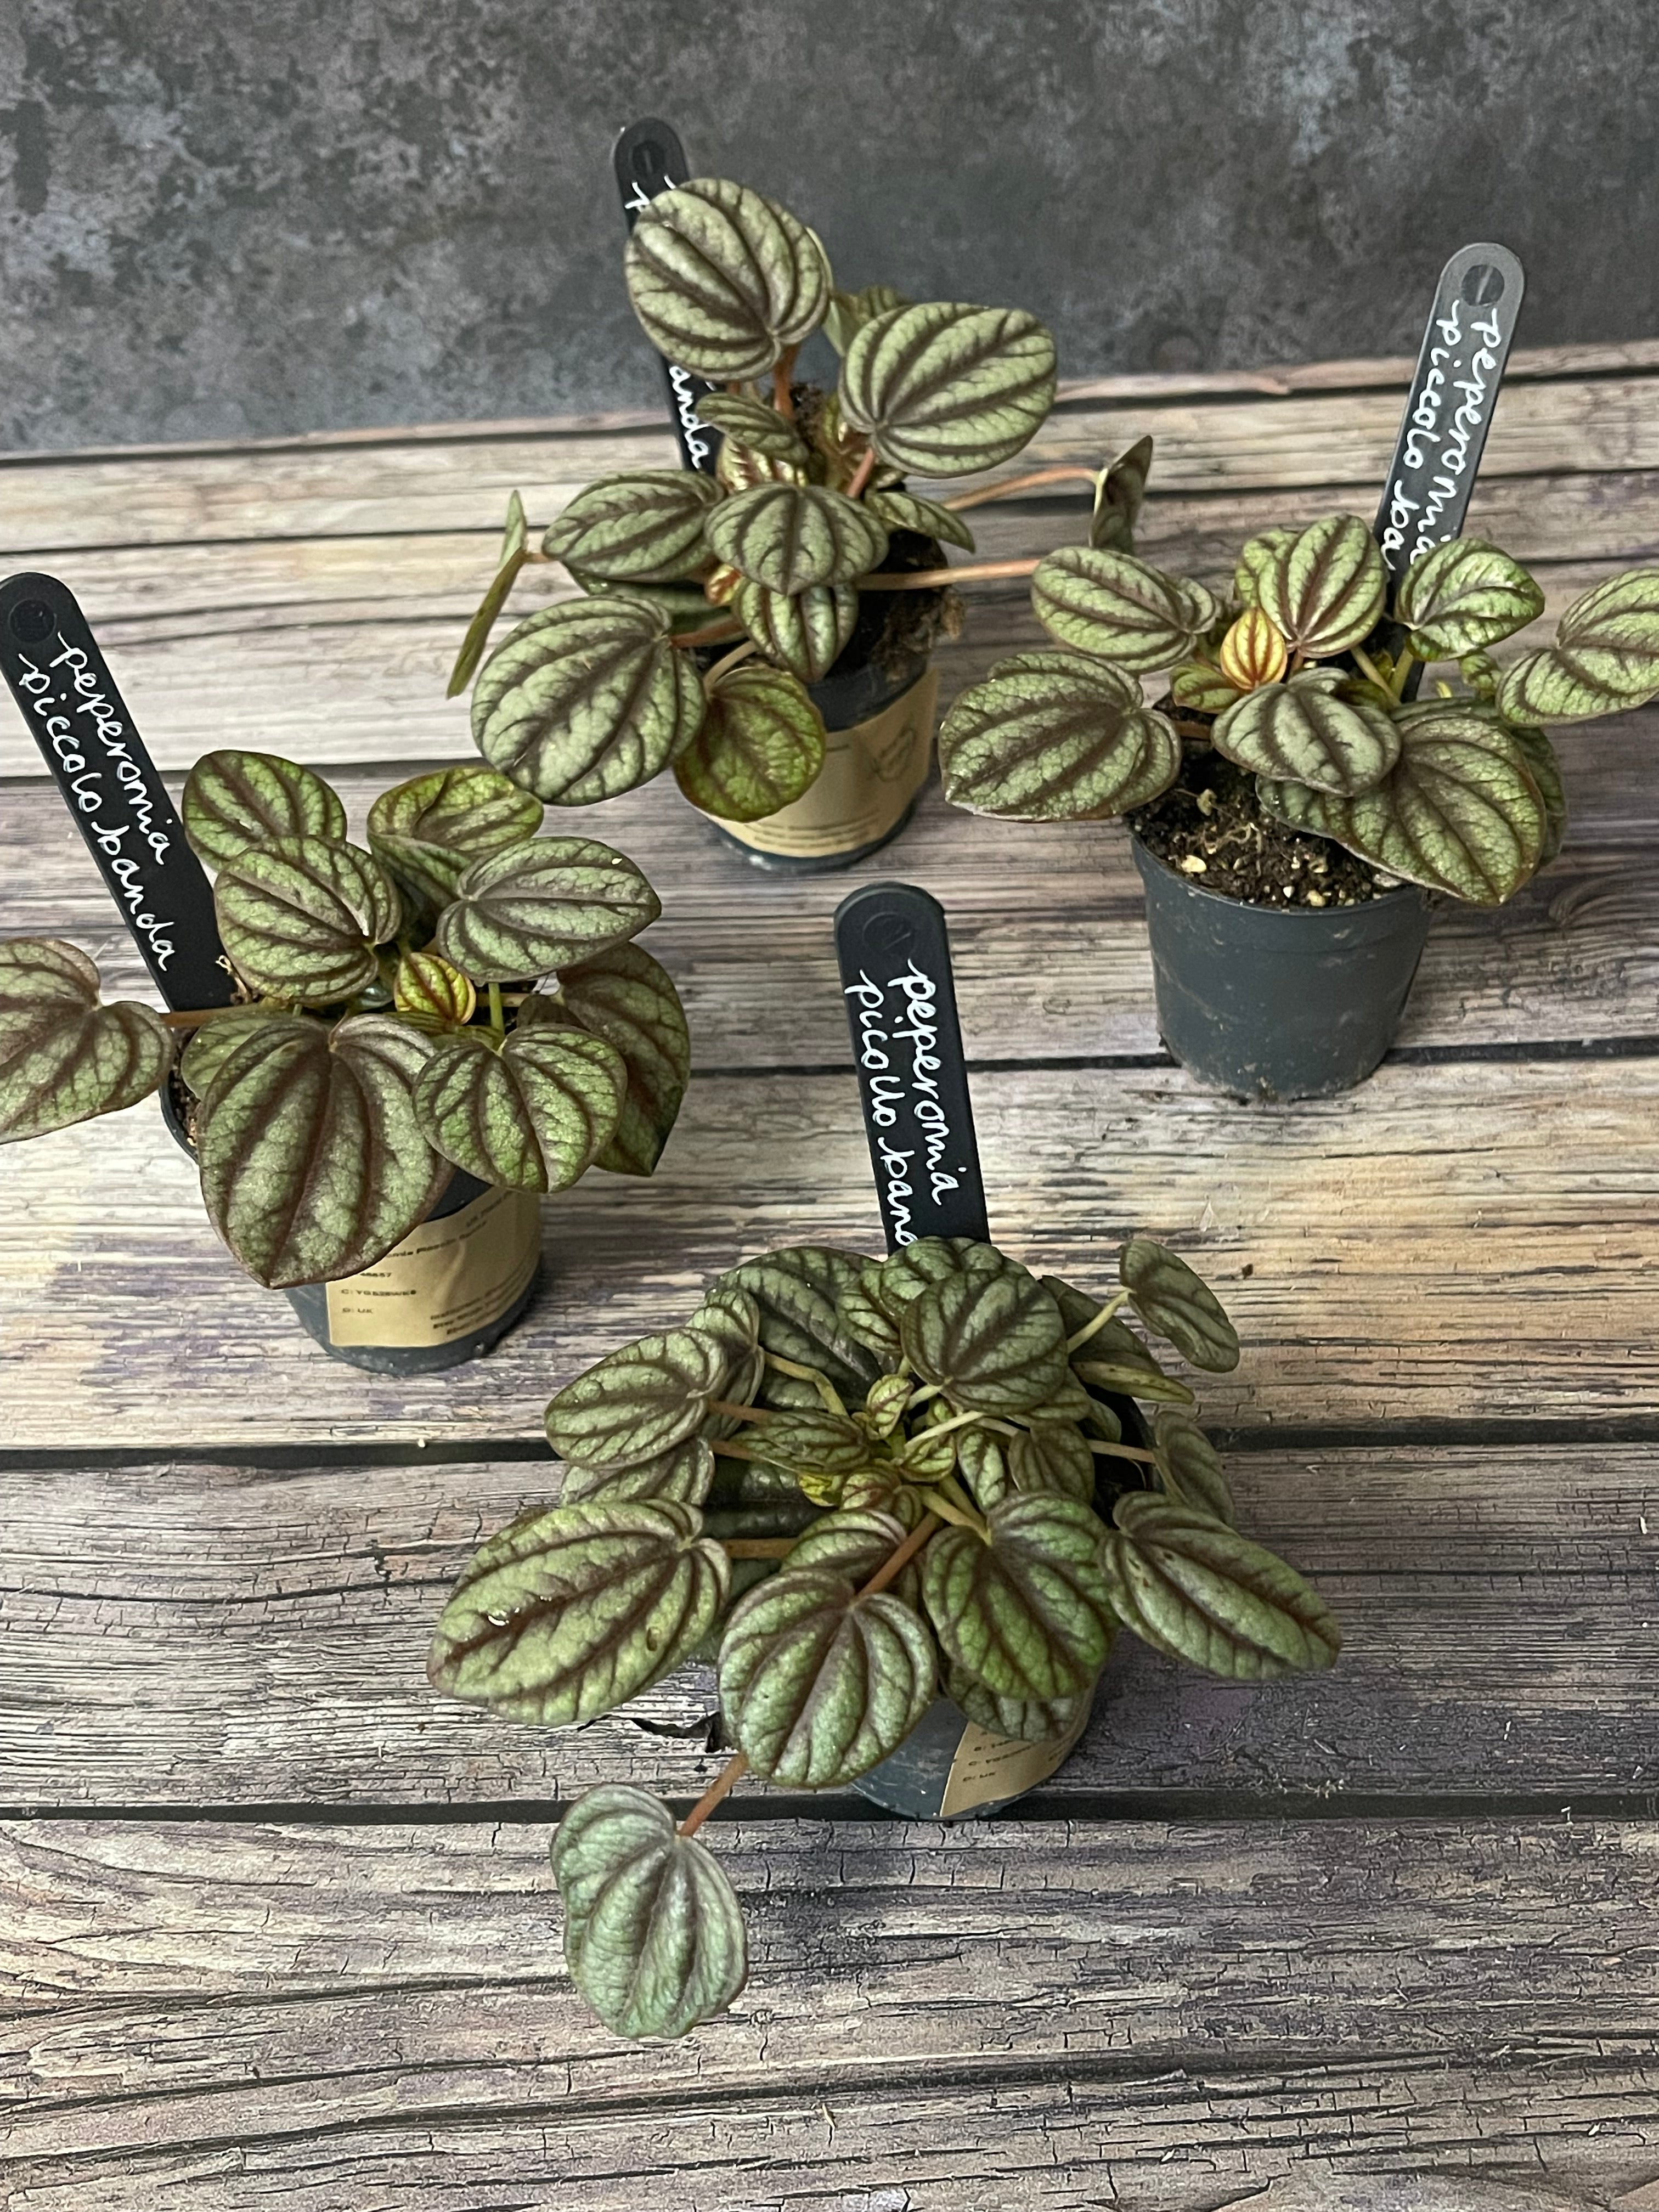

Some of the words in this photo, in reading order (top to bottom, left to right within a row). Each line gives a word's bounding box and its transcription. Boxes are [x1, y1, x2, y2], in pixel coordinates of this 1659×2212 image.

[669, 366, 710, 469] anda
[1403, 299, 1463, 470] piccolo
[1410, 307, 1502, 566] peperomia
[19, 653, 102, 812] piccolo
[91, 821, 176, 972] banda
[49, 631, 172, 865] peperomia
[887, 958, 967, 1206] peperomia
